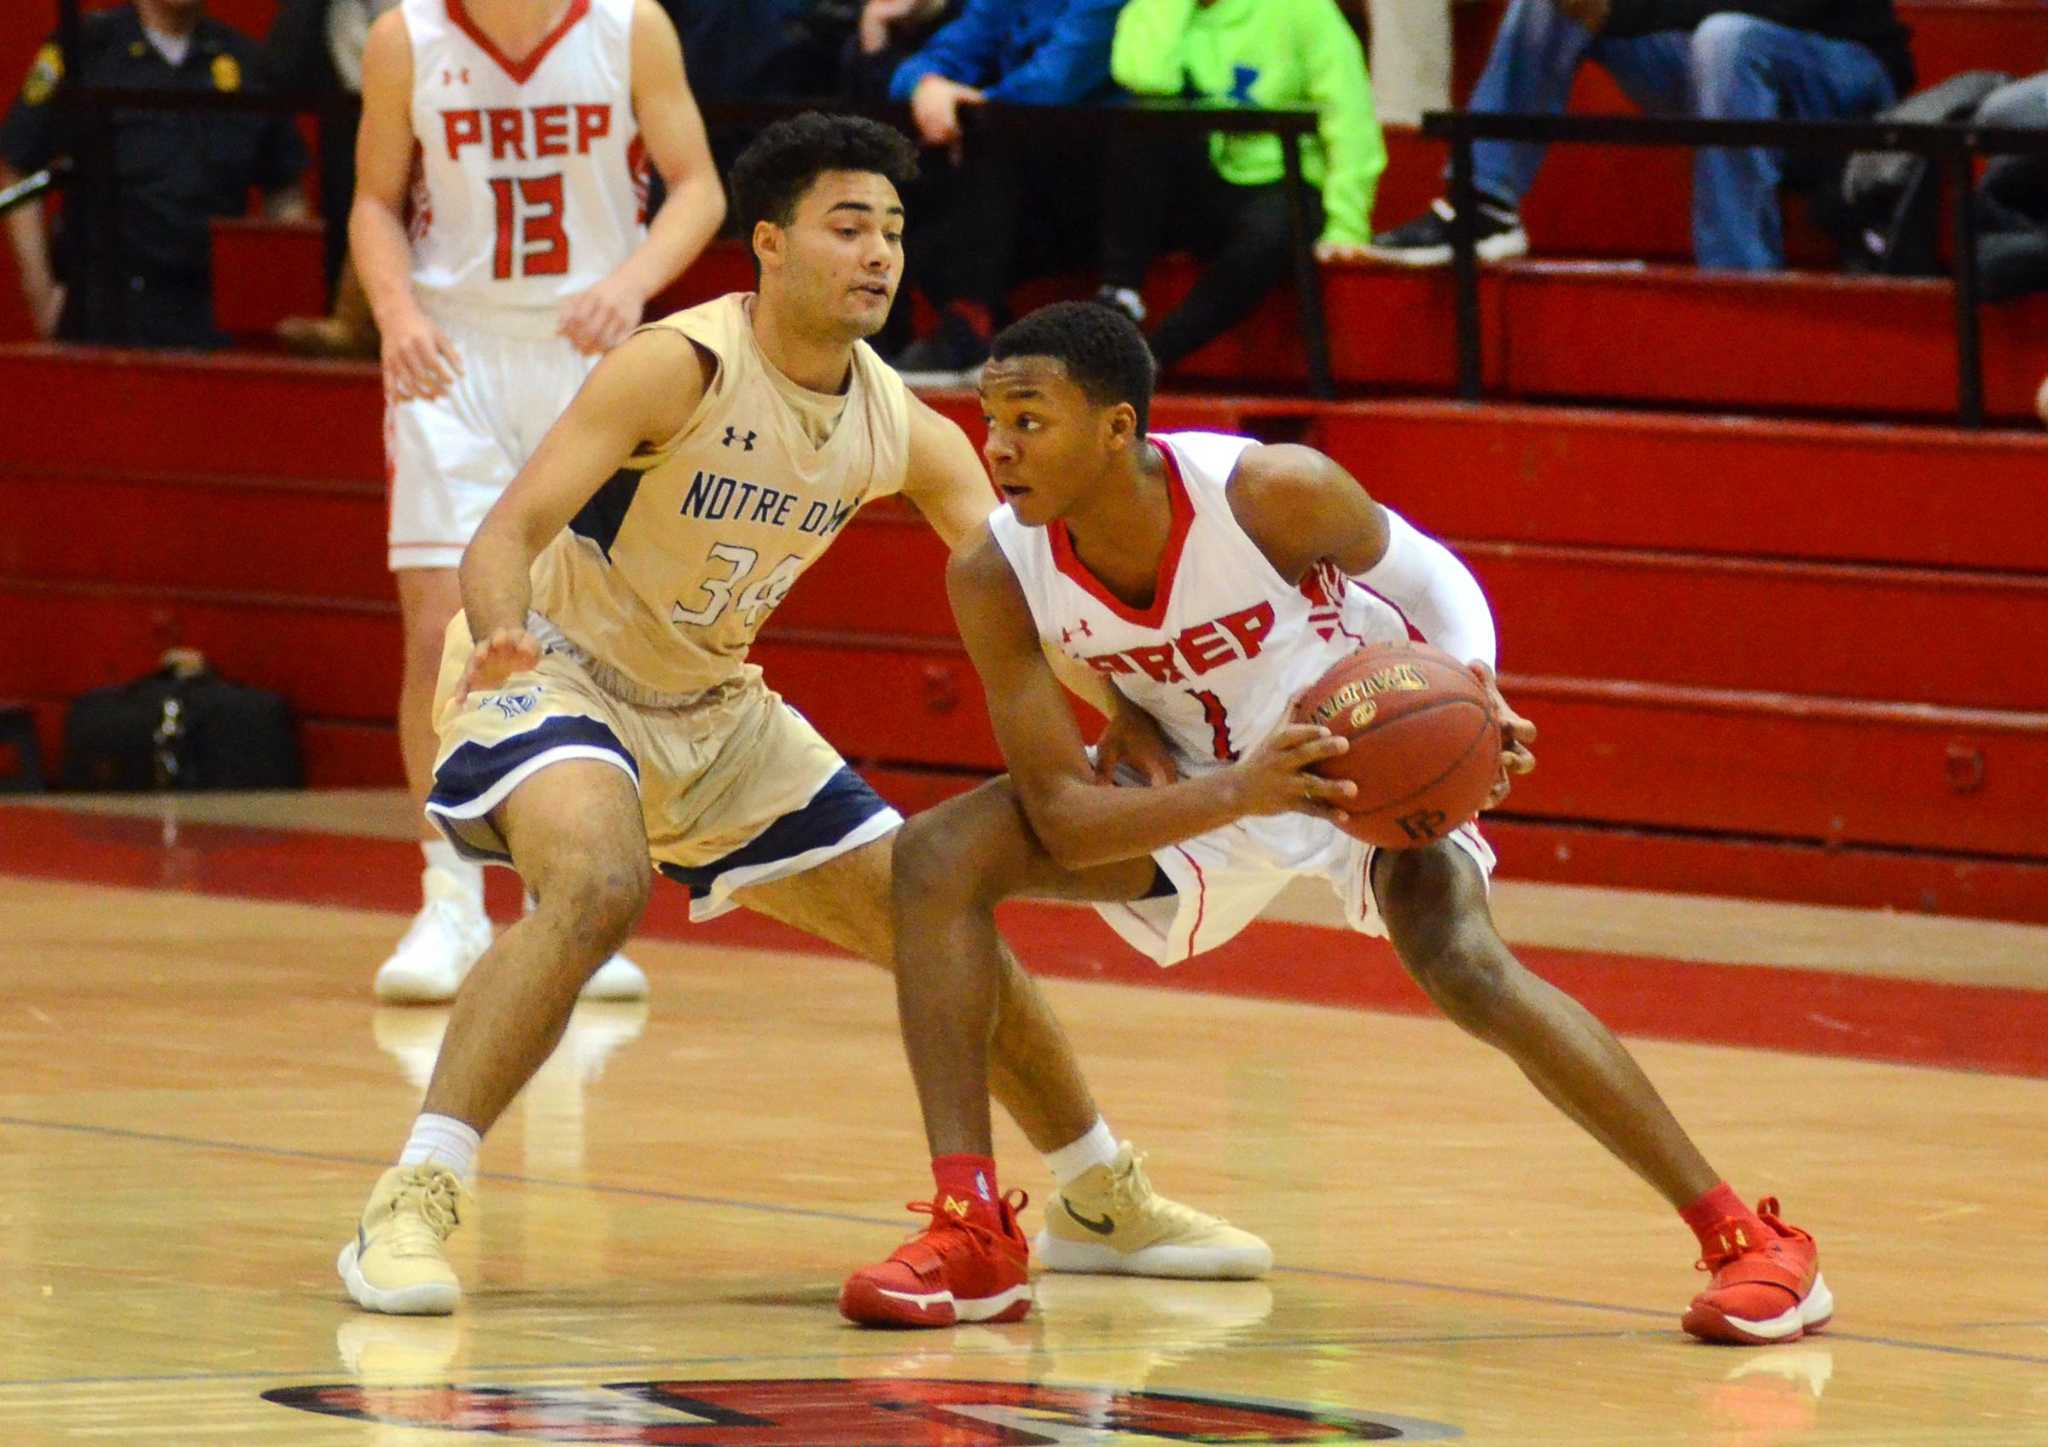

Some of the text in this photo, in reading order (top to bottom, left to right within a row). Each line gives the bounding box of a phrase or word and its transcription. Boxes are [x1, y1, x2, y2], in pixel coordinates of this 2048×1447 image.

[441, 104, 611, 161] PREP
[489, 173, 570, 280] 13
[680, 471, 798, 526] NOTRE
[671, 541, 803, 628] 34
[1185, 688, 1241, 763] 1
